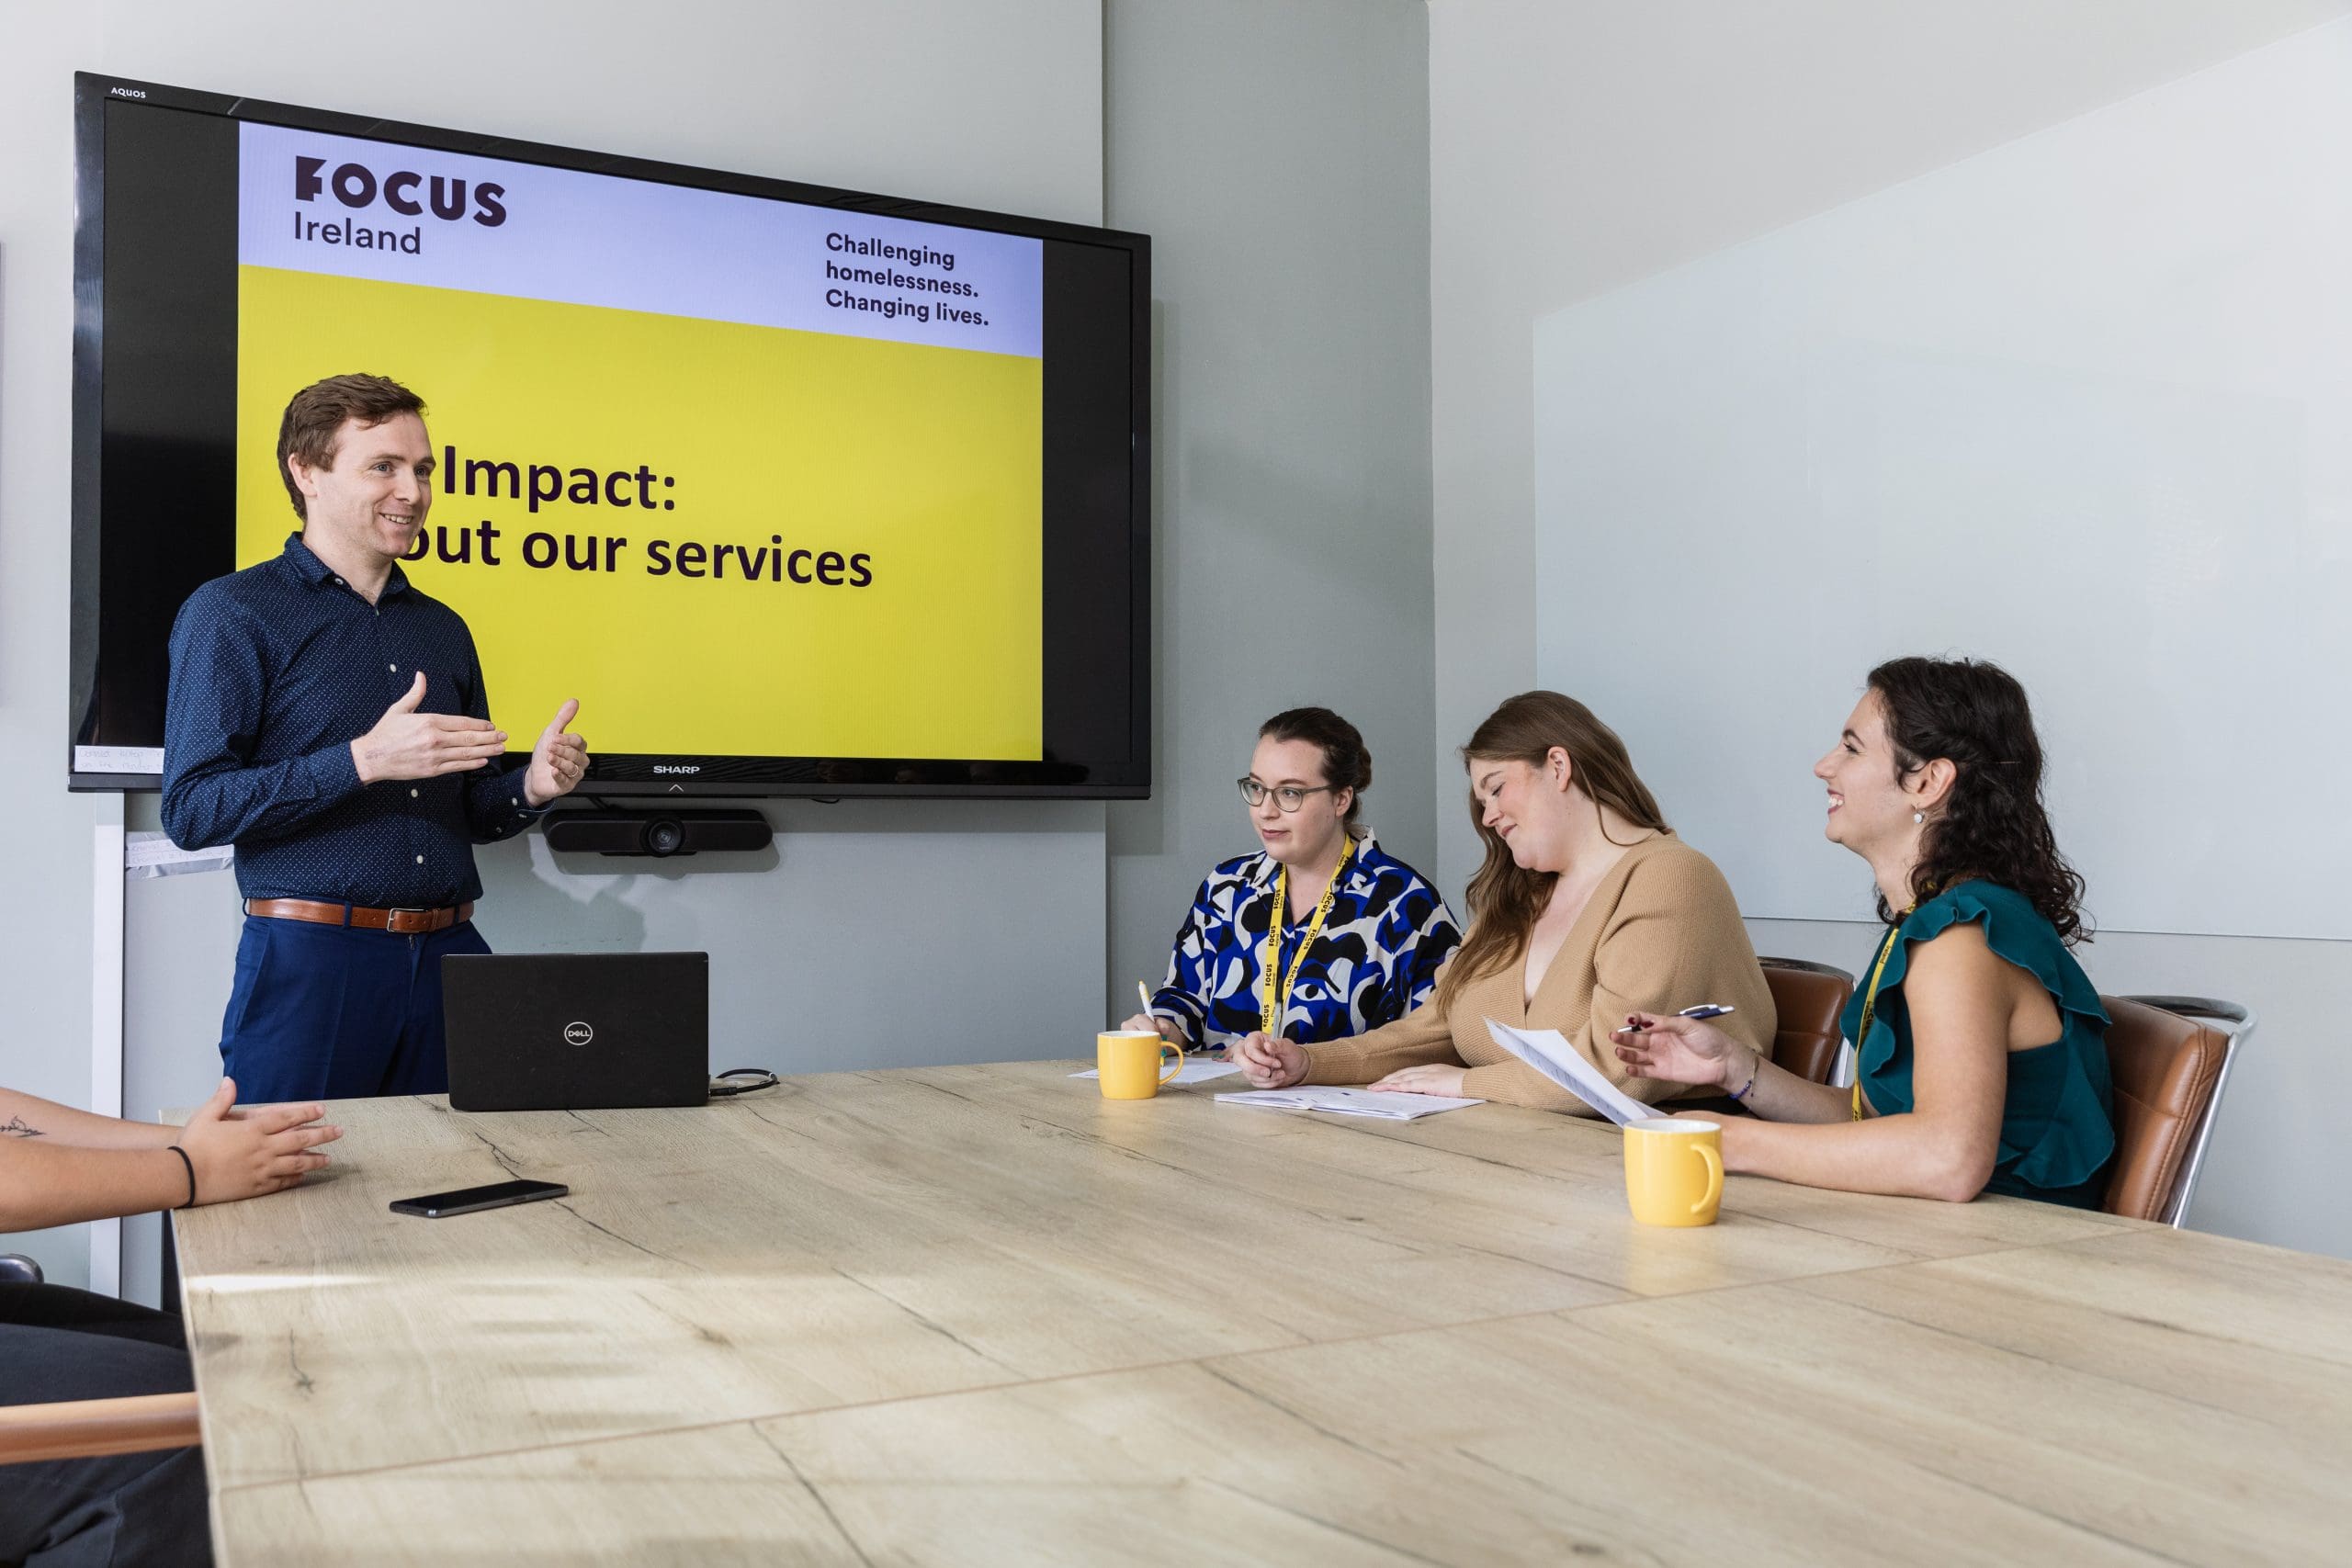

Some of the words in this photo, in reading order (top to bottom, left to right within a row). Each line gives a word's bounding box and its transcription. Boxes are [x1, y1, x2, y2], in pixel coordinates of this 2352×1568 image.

[111, 87, 146, 98] AQUOS
[295, 155, 507, 228] FOCUS
[295, 211, 422, 255] Ireland
[825, 232, 956, 271] Challenging
[826, 260, 979, 298] homelessness.
[825, 288, 930, 322] Changing
[936, 301, 989, 326] lives.
[444, 445, 676, 513] Impact:
[522, 531, 628, 572] our
[646, 535, 874, 588] services
[653, 765, 700, 774] SHARP
[1268, 925, 1277, 948] FOCUS
[1304, 929, 1317, 950] FOCUS
[1264, 964, 1272, 987] FOCUS
